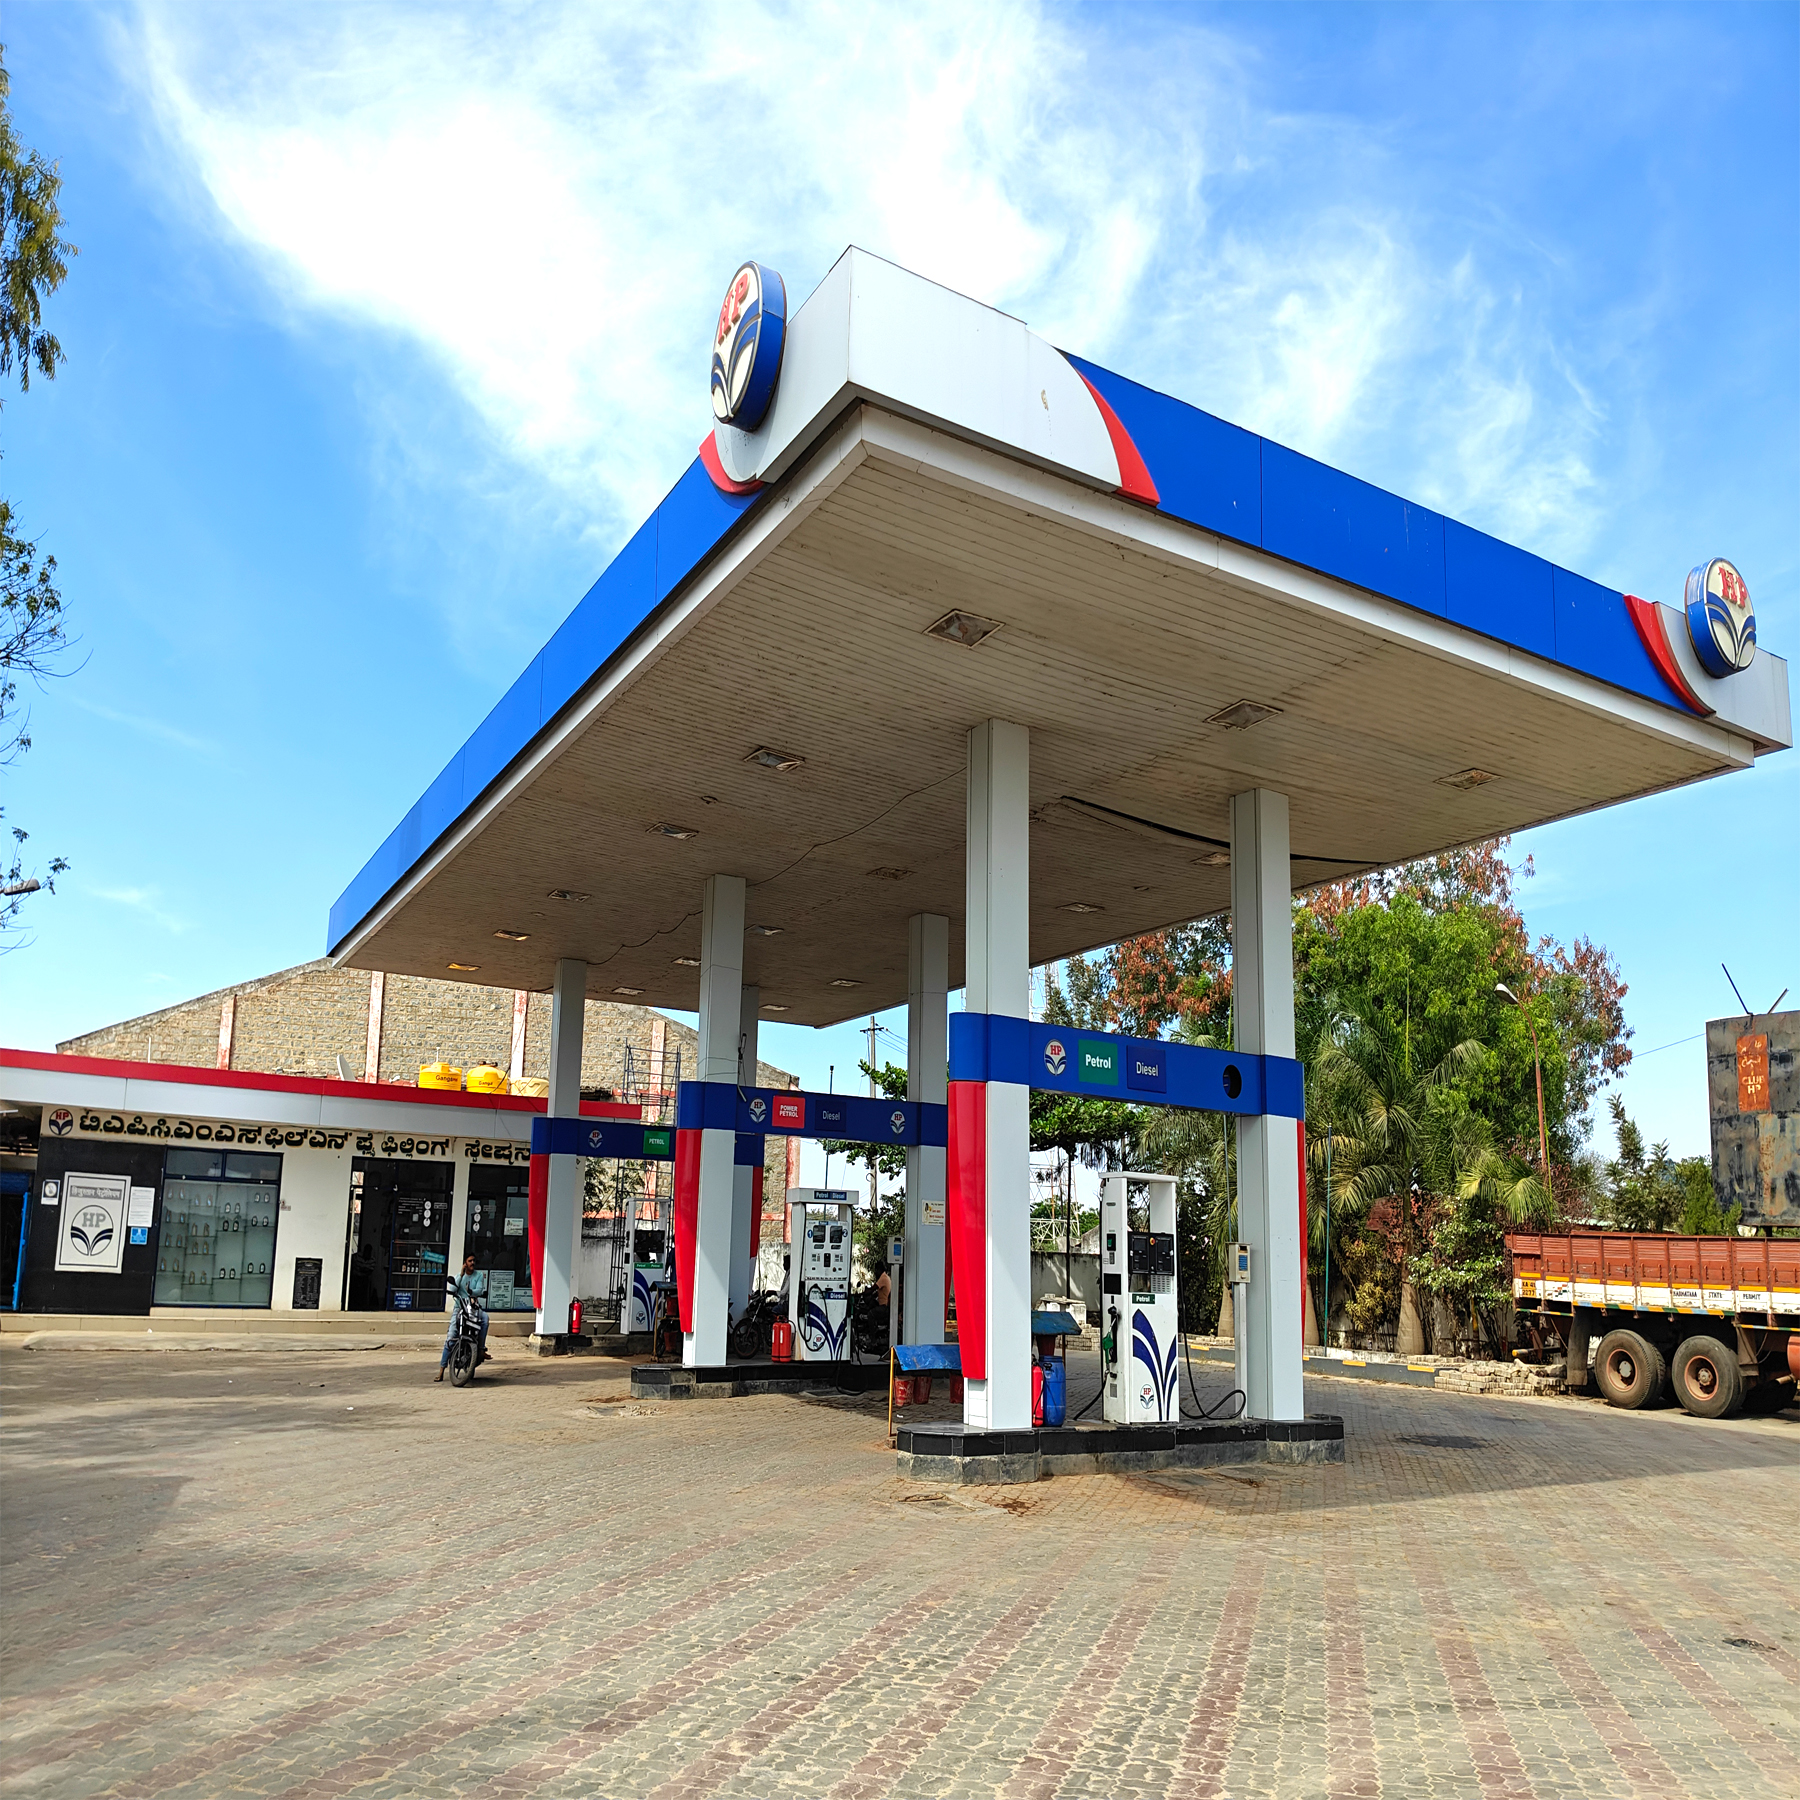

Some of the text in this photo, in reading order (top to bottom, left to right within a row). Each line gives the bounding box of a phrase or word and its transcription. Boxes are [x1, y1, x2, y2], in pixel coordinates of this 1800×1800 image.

[718, 272, 750, 346] HP
[1718, 566, 1748, 609] HP
[1050, 1044, 1062, 1056] HP
[1085, 1054, 1111, 1069] Petrol
[1136, 1061, 1159, 1077] Diesel
[55, 1111, 70, 1121] HP
[779, 1110, 798, 1118] PETROL
[822, 1110, 841, 1121] Diesel
[894, 1113, 903, 1121] HP
[815, 1190, 829, 1198] Petrol
[82, 1212, 106, 1228] HP
